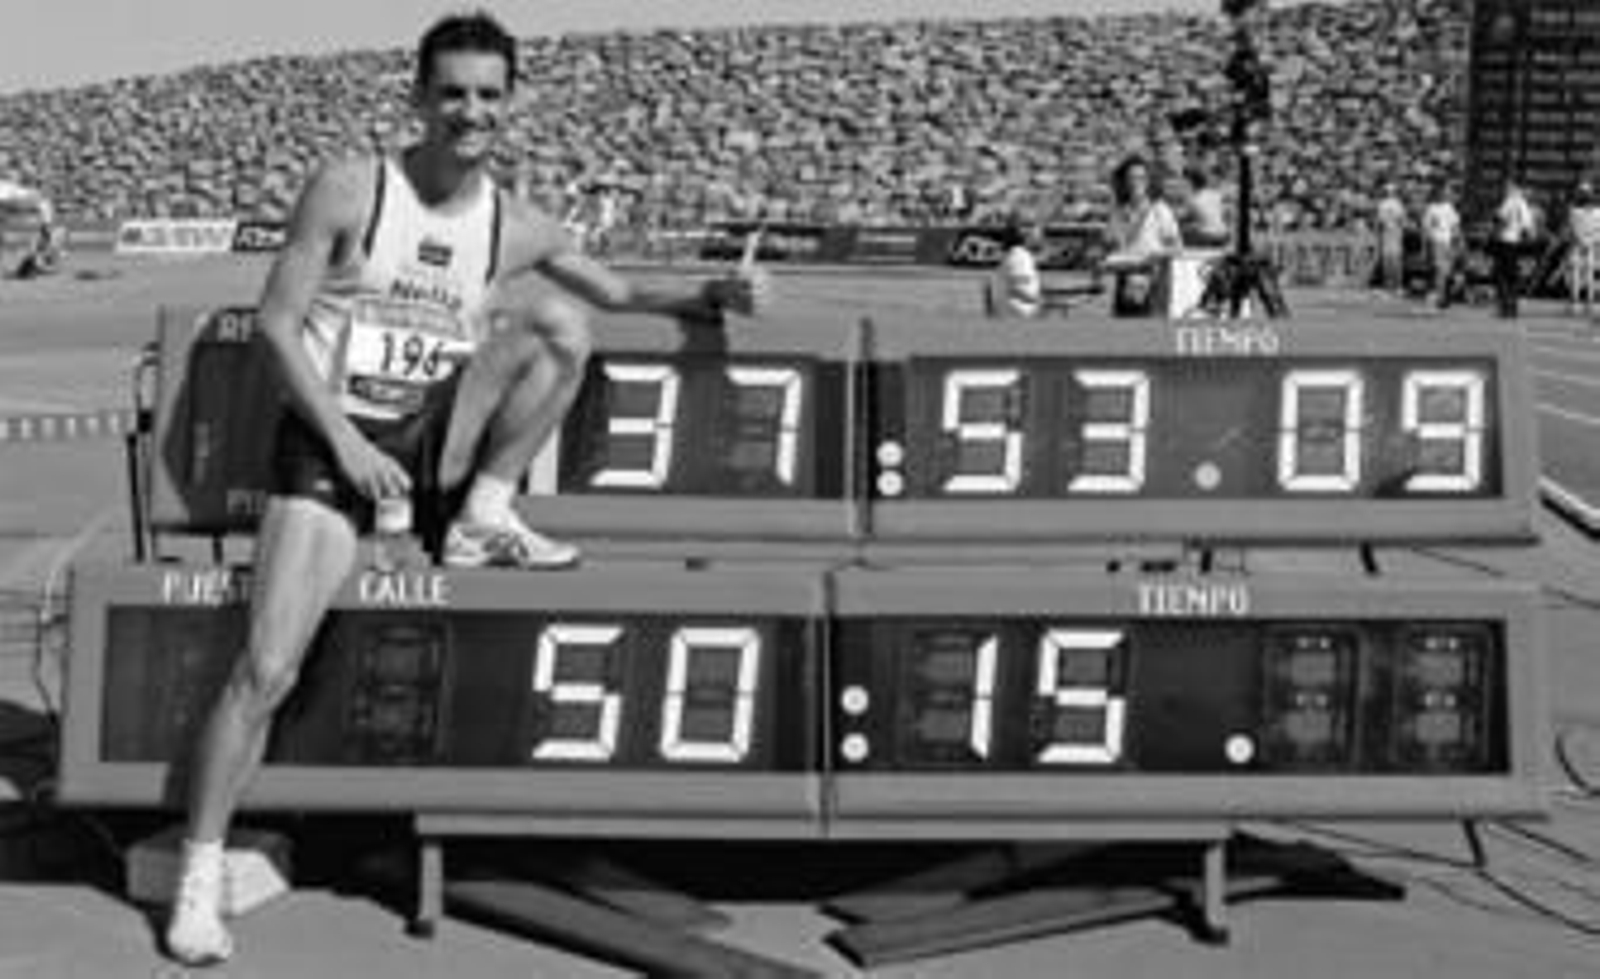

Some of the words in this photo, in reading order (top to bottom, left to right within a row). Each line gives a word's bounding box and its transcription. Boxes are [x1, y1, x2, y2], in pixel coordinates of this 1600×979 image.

[379, 332, 445, 378] 196
[1175, 327, 1280, 356] TIEMPO
[359, 573, 450, 606] CALLE
[1137, 583, 1250, 616] TIEMPO
